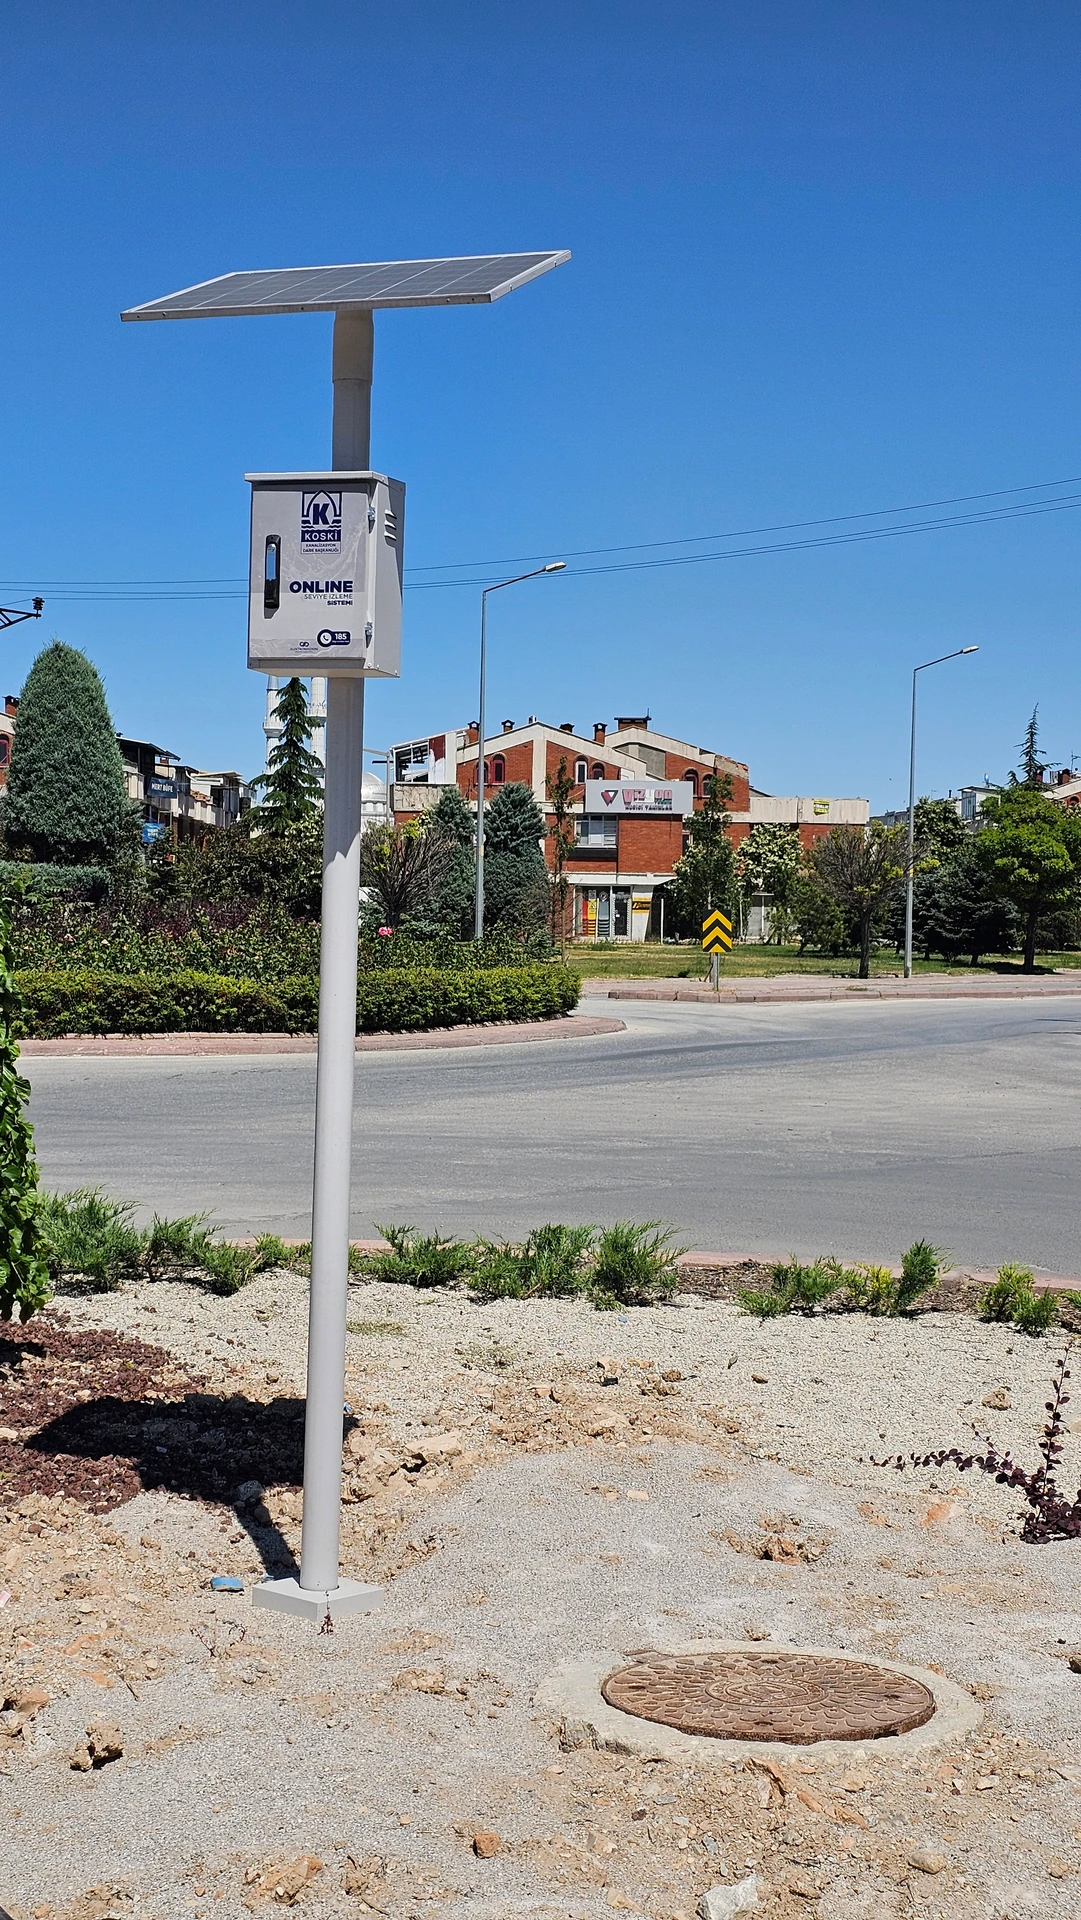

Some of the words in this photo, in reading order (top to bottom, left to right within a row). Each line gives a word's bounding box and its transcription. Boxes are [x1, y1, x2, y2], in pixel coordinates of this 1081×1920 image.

[312, 503, 330, 525] K
[304, 530, 338, 541] KOSKİ
[289, 580, 353, 593] ONLINE
